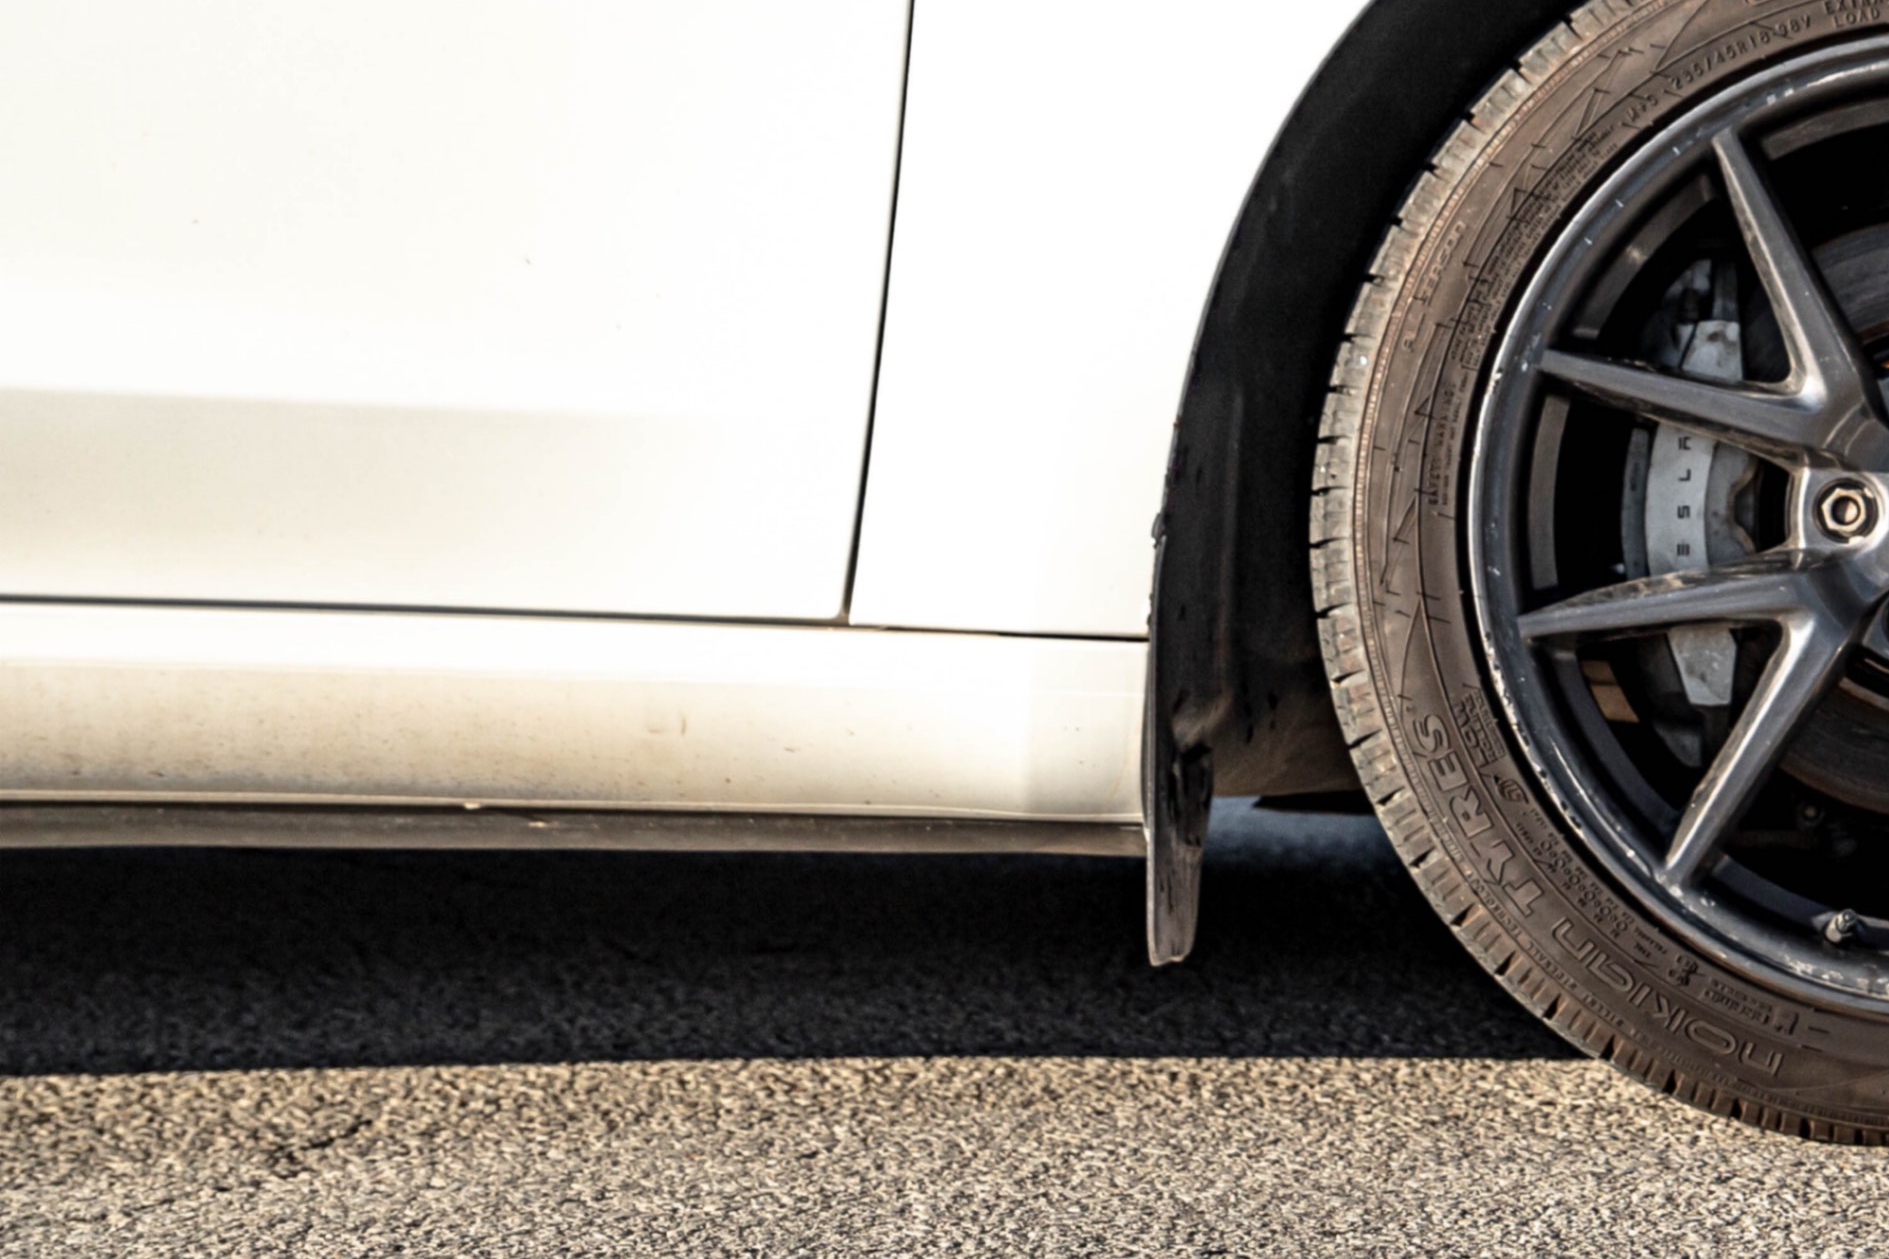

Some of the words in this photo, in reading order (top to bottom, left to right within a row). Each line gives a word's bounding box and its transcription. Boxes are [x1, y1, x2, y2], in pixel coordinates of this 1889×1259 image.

[1832, 7, 1880, 26] LOAD
[1677, 436, 1691, 556] ESLA
[1405, 709, 1552, 917] TYRES
